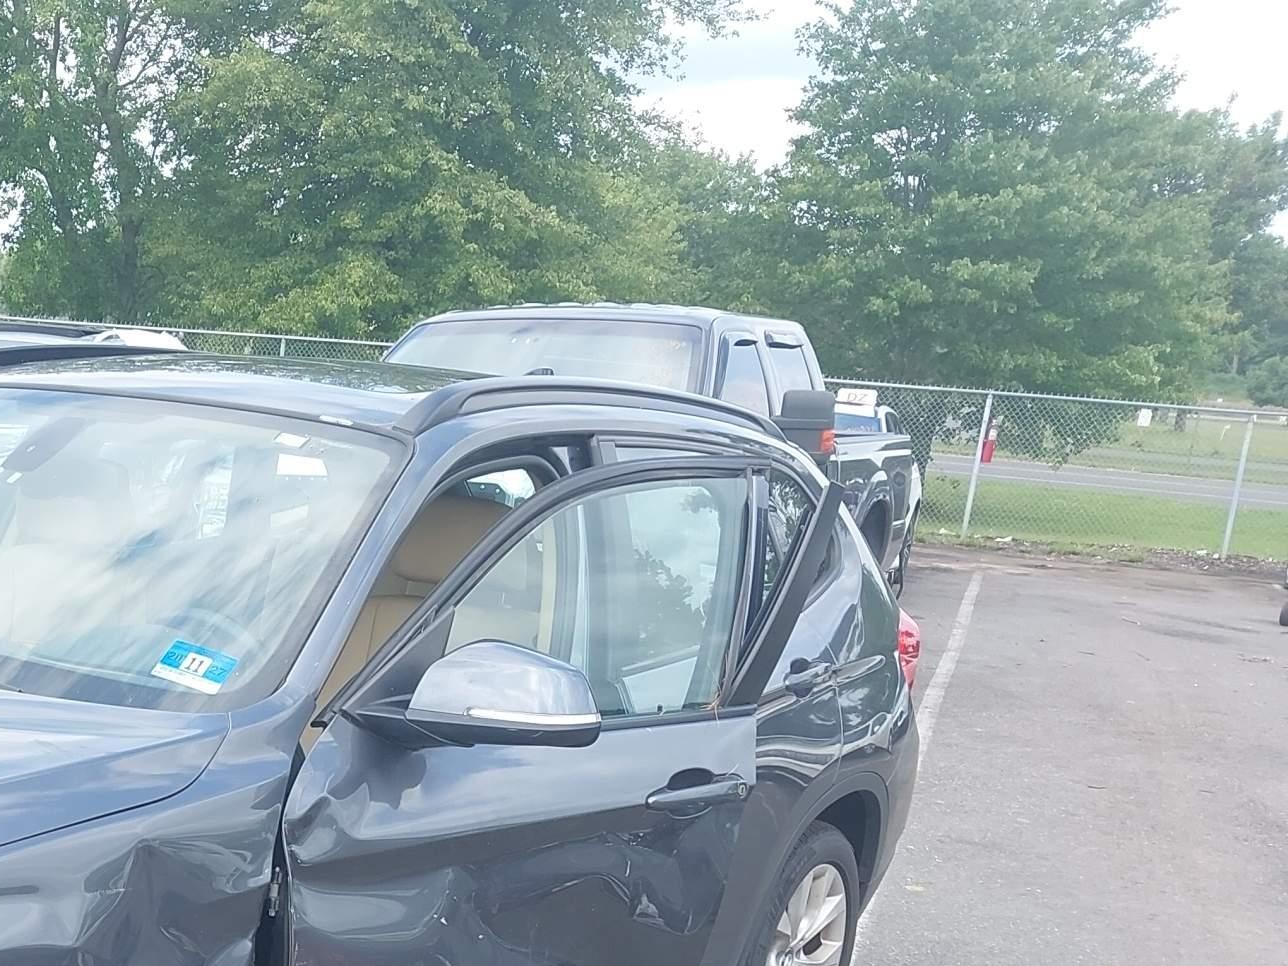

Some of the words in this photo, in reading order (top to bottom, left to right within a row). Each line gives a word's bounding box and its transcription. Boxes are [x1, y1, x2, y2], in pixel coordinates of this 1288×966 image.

[847, 392, 869, 402] DZ
[184, 657, 205, 673] 11
[208, 664, 228, 678] 27
